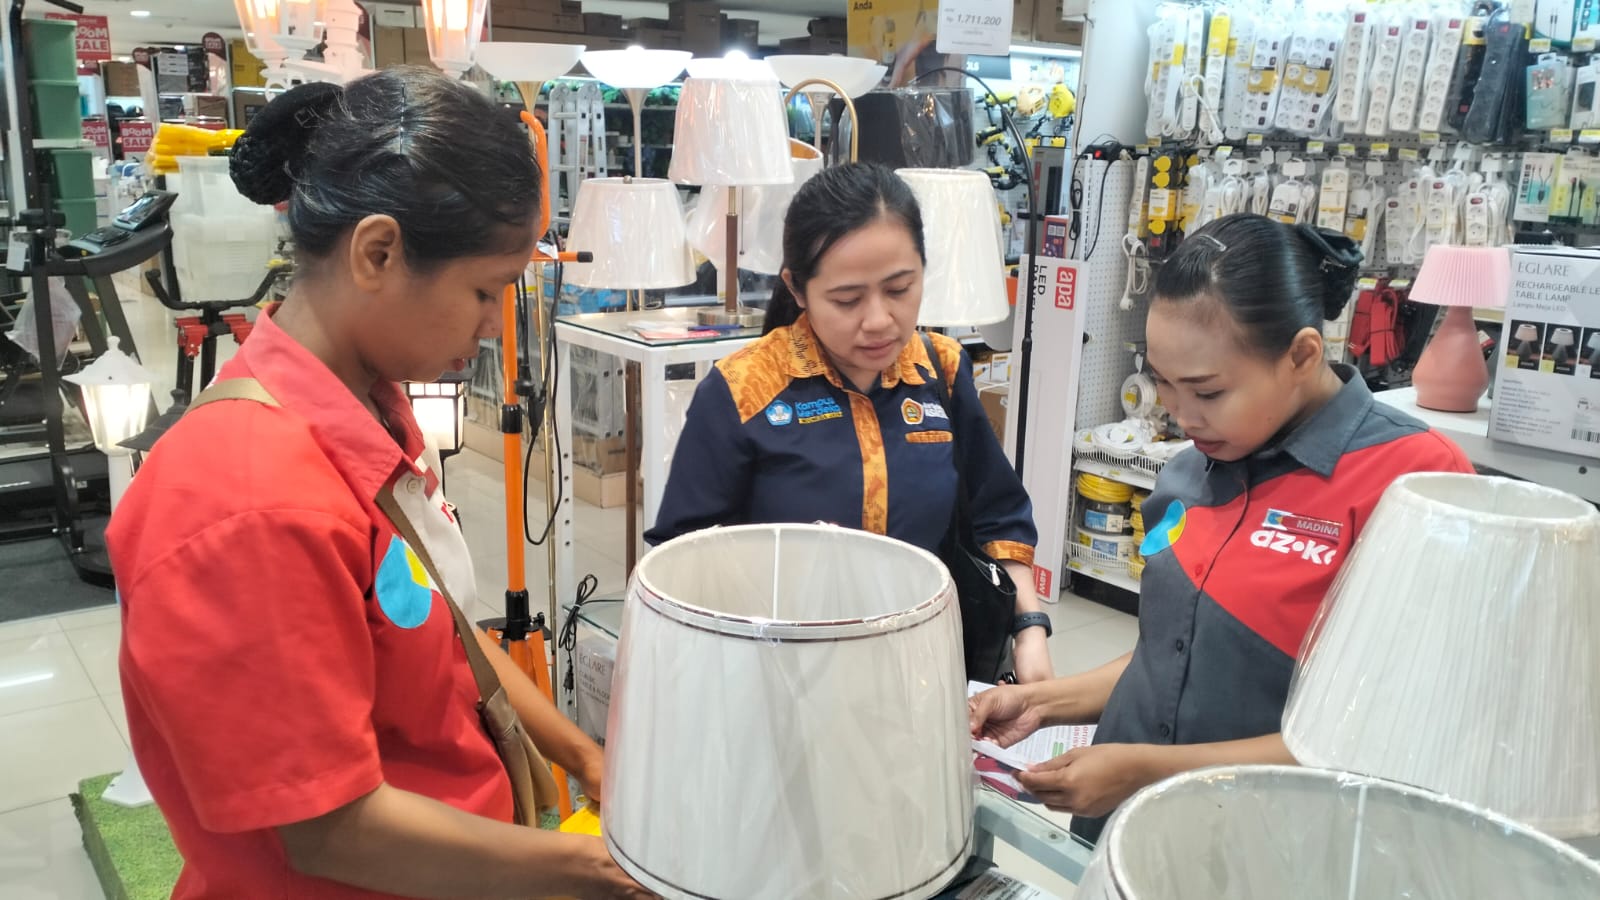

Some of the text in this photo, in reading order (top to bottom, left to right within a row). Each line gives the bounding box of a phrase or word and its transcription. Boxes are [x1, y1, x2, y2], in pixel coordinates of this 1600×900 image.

[853, 0, 872, 11] Anda
[957, 13, 1001, 26] 1.711.200
[1518, 262, 1569, 277] EGLARE
[1038, 265, 1047, 294] LED
[1057, 270, 1074, 308] apa
[1515, 280, 1587, 295] RECHARGEABLE
[1515, 290, 1571, 304] TABLE LAMP
[1296, 520, 1340, 536] MADINA
